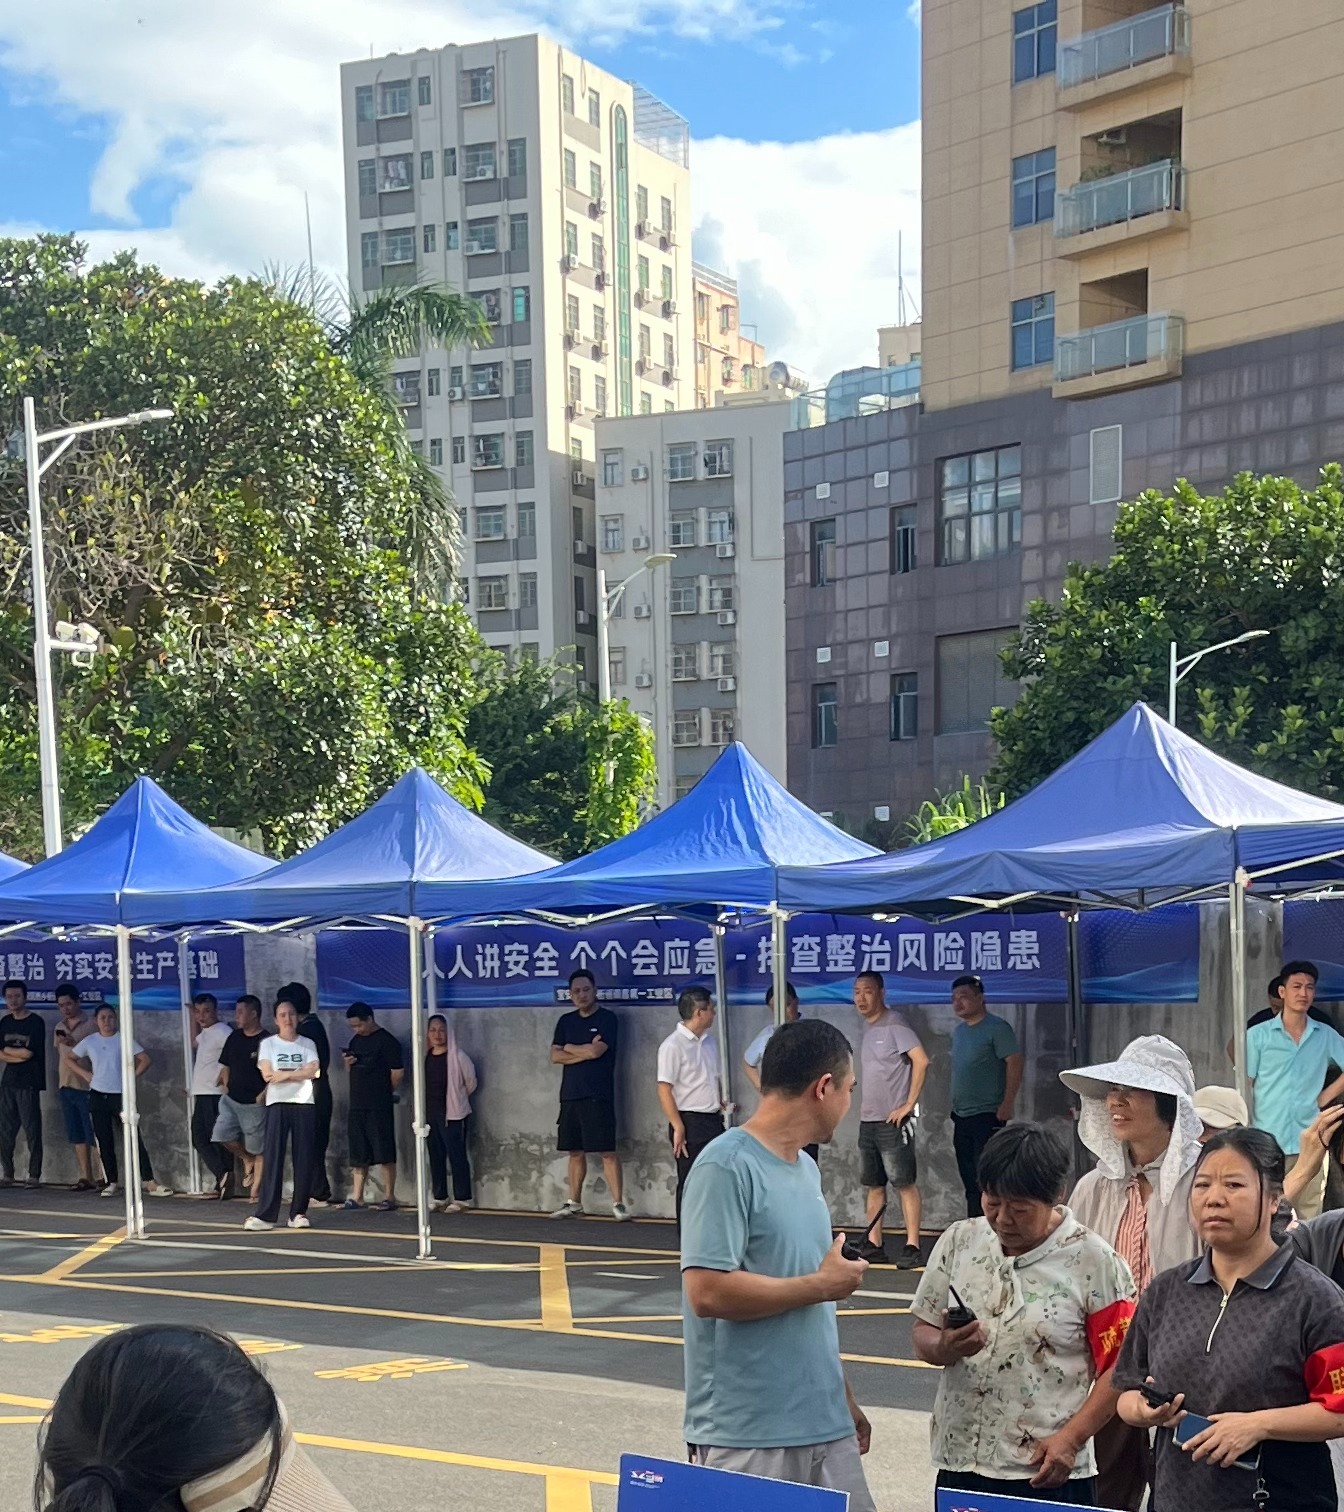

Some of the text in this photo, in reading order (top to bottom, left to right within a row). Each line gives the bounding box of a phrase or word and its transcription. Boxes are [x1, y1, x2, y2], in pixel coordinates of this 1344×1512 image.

[55, 950, 219, 982] 夯实安生产基础
[570, 937, 716, 977] 个个会应急
